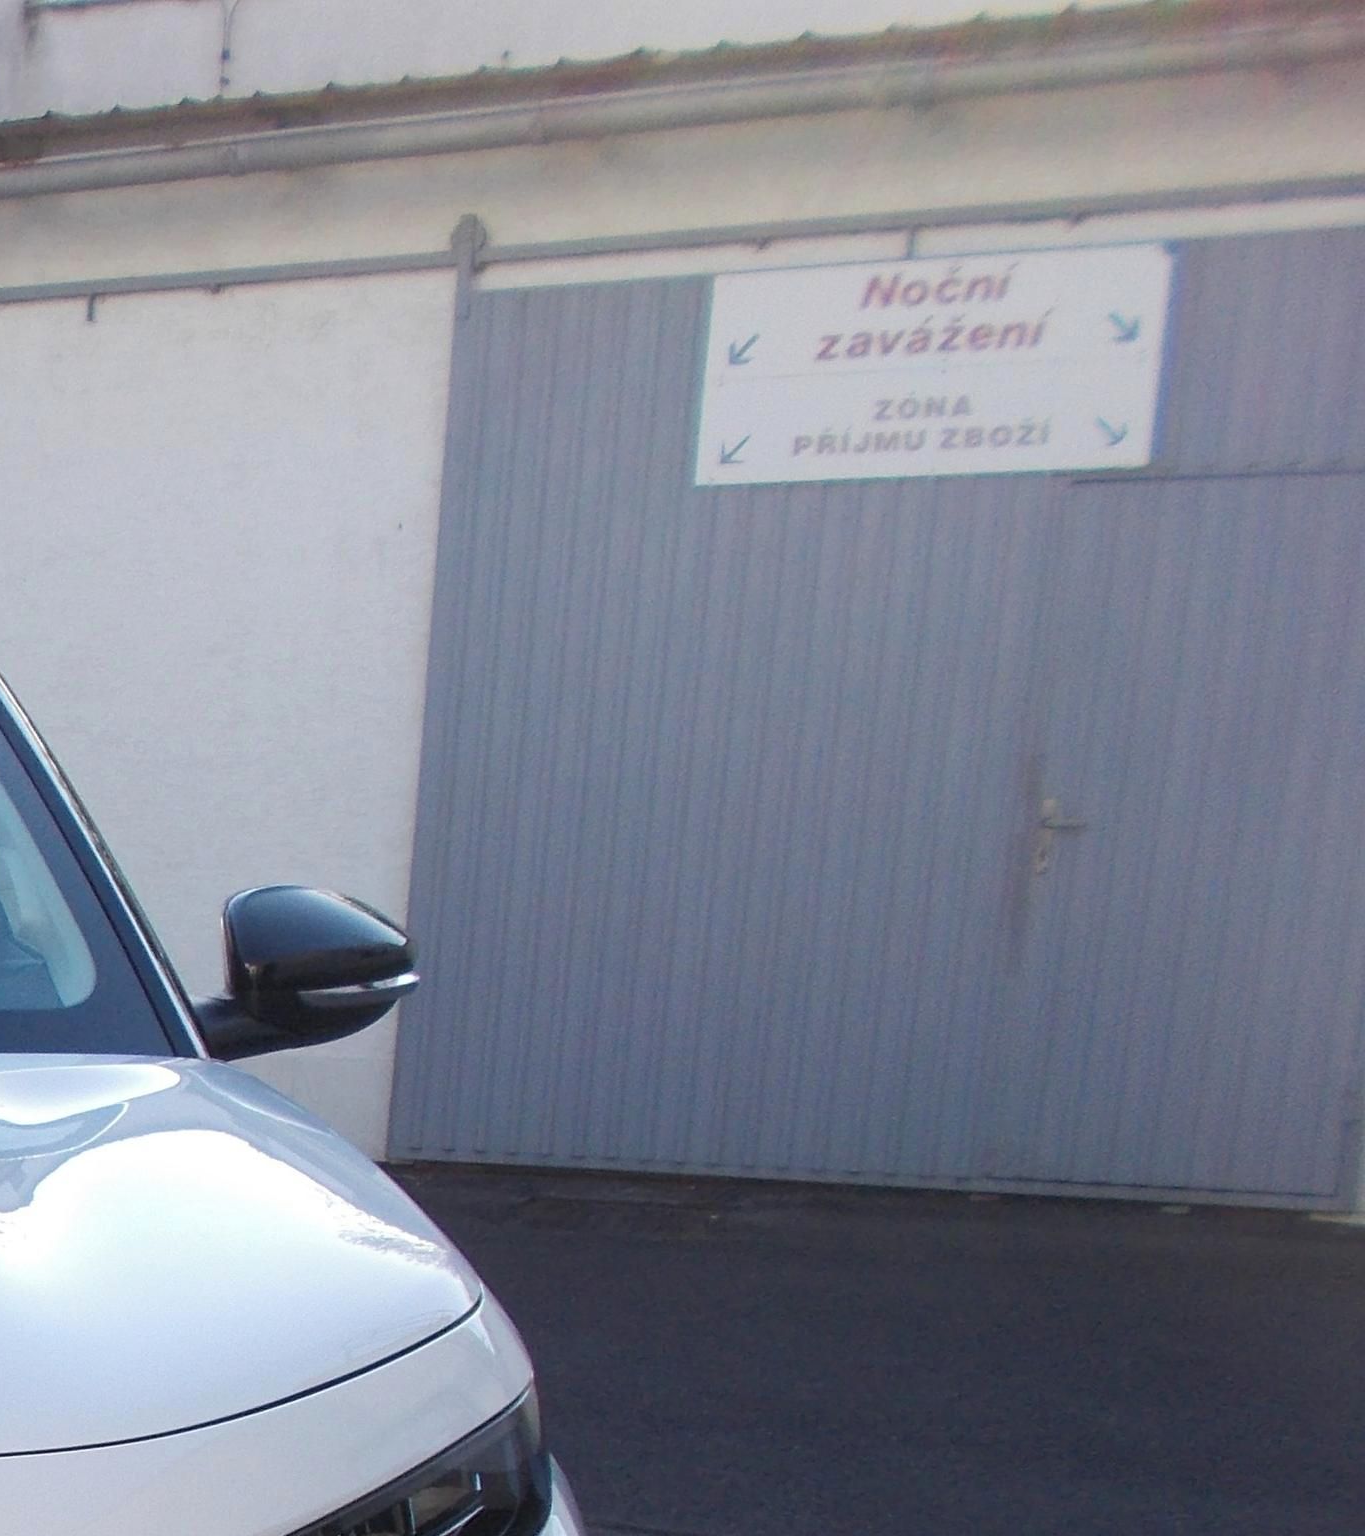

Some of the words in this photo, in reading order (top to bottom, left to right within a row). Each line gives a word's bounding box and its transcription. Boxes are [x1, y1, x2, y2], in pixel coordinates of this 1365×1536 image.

[859, 262, 1019, 309] Noční
[815, 303, 1058, 361] zavážení
[792, 426, 928, 456] PŘÍJMU
[940, 416, 1053, 449] ZBOŽÍ
